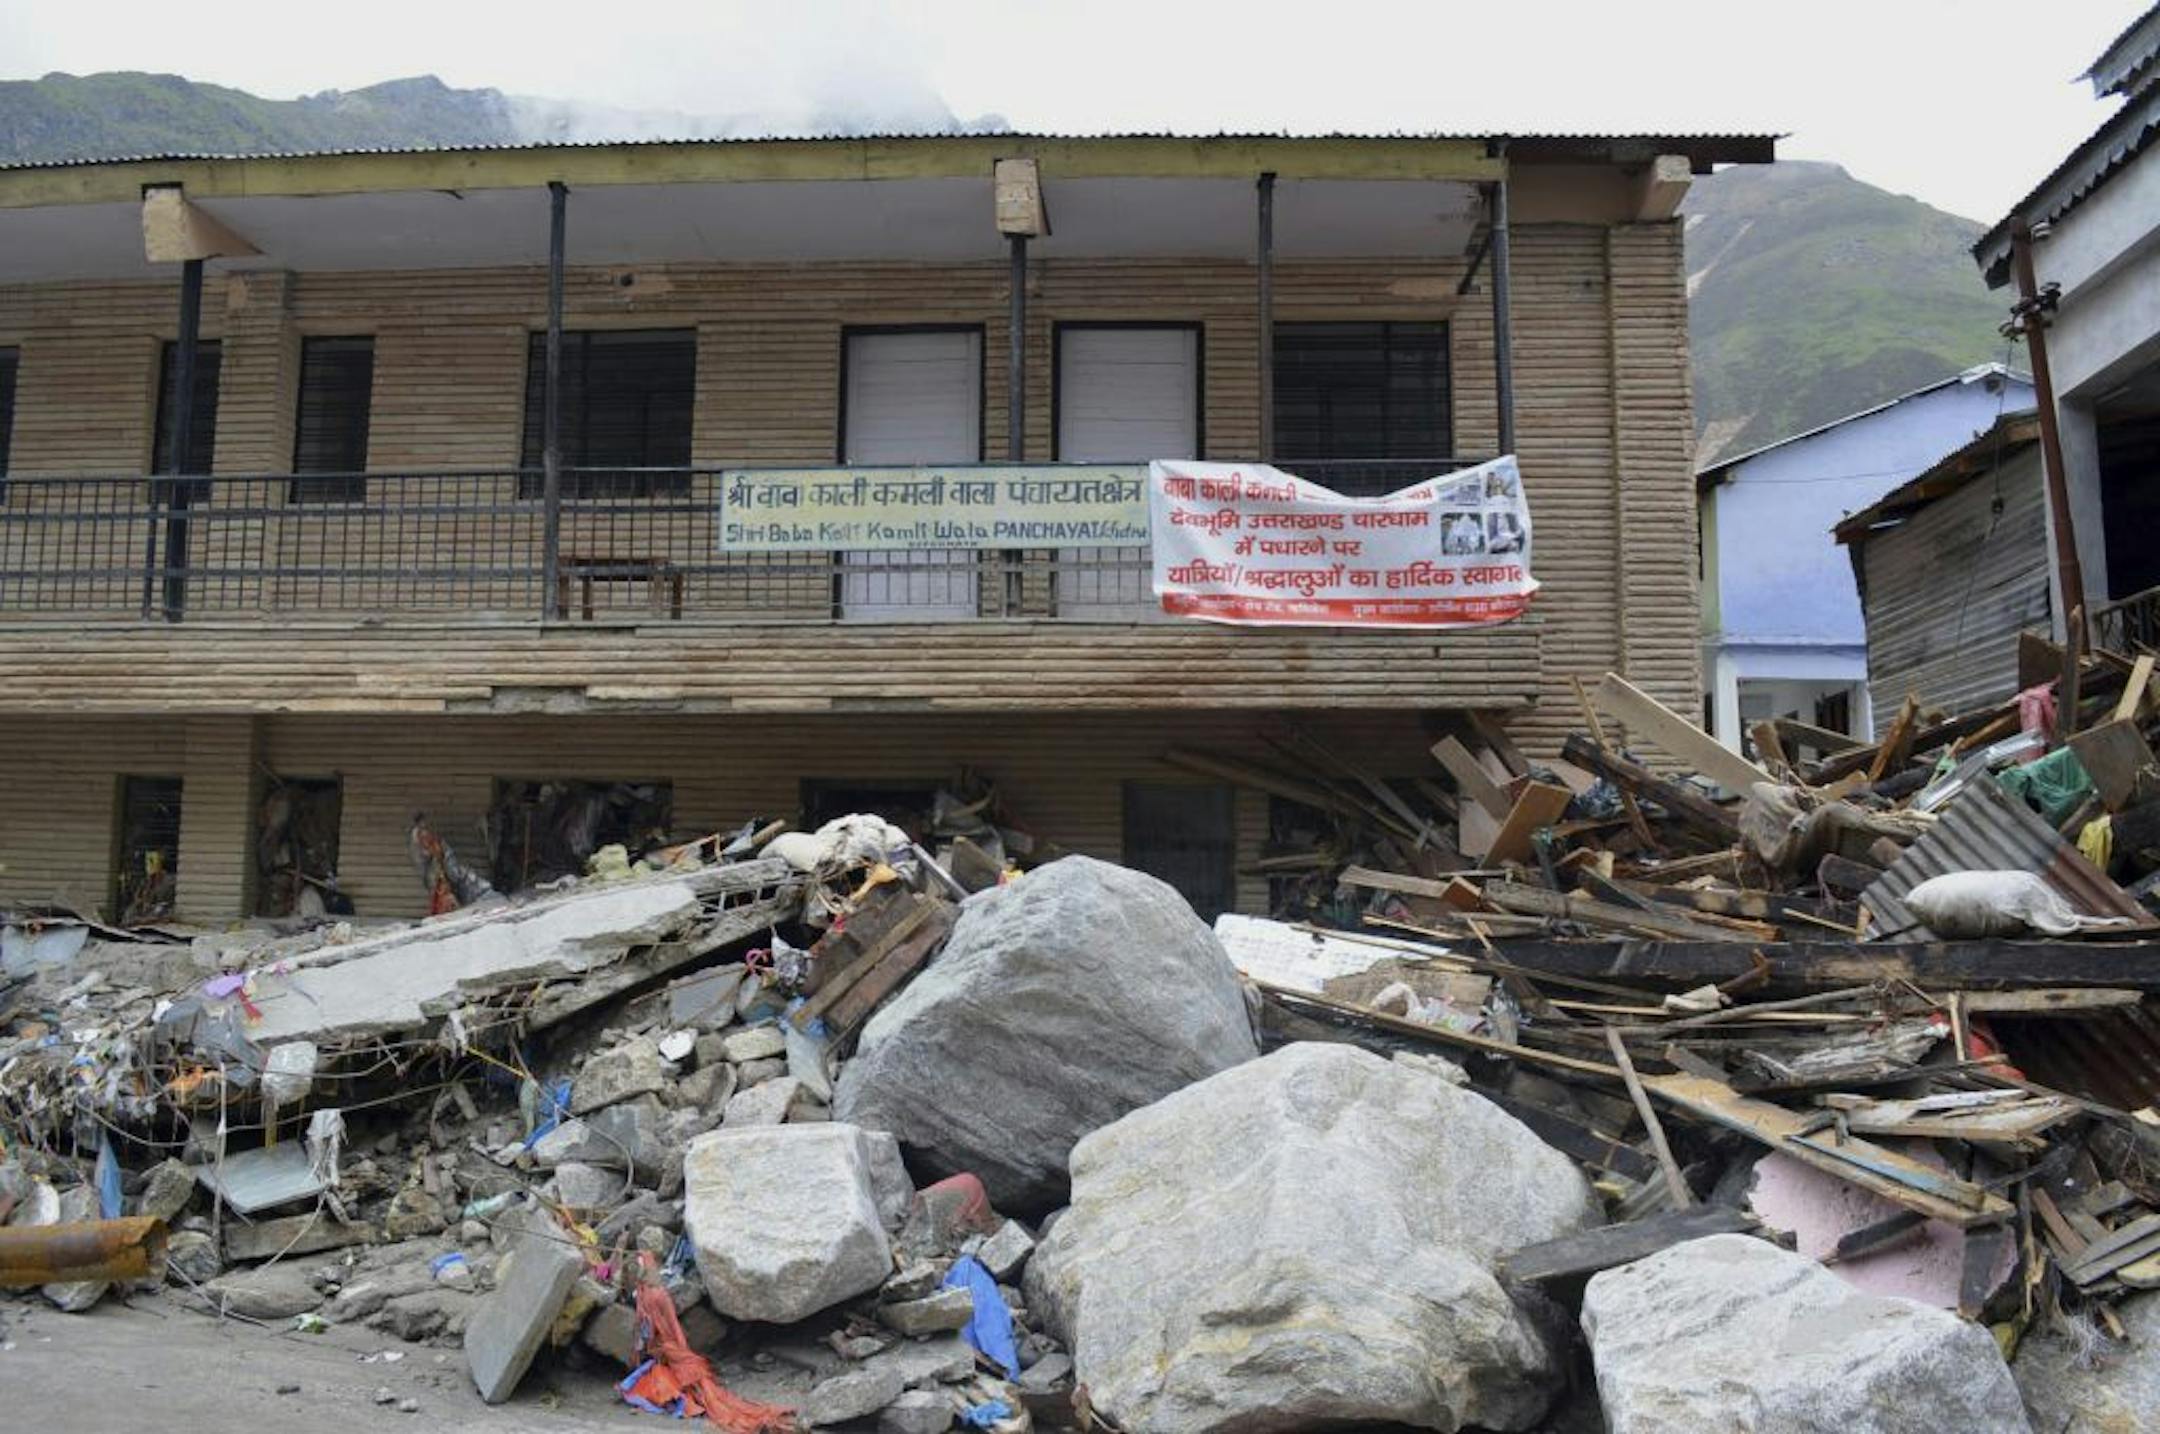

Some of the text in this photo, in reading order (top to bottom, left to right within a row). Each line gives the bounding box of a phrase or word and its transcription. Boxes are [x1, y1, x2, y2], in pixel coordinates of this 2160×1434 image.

[728, 476, 755, 508] श्री
[809, 476, 870, 507] काली
[873, 475, 947, 507] कमली
[726, 522, 764, 542] Shri
[769, 523, 813, 543] Baba
[933, 520, 988, 538] Wala
[1170, 507, 1240, 536] देवभूमि
[1352, 511, 1430, 528] चारधाम
[1235, 535, 1363, 556] में पधारने पर
[1348, 568, 1382, 588] का
[1386, 560, 1457, 589] हार्दिक
